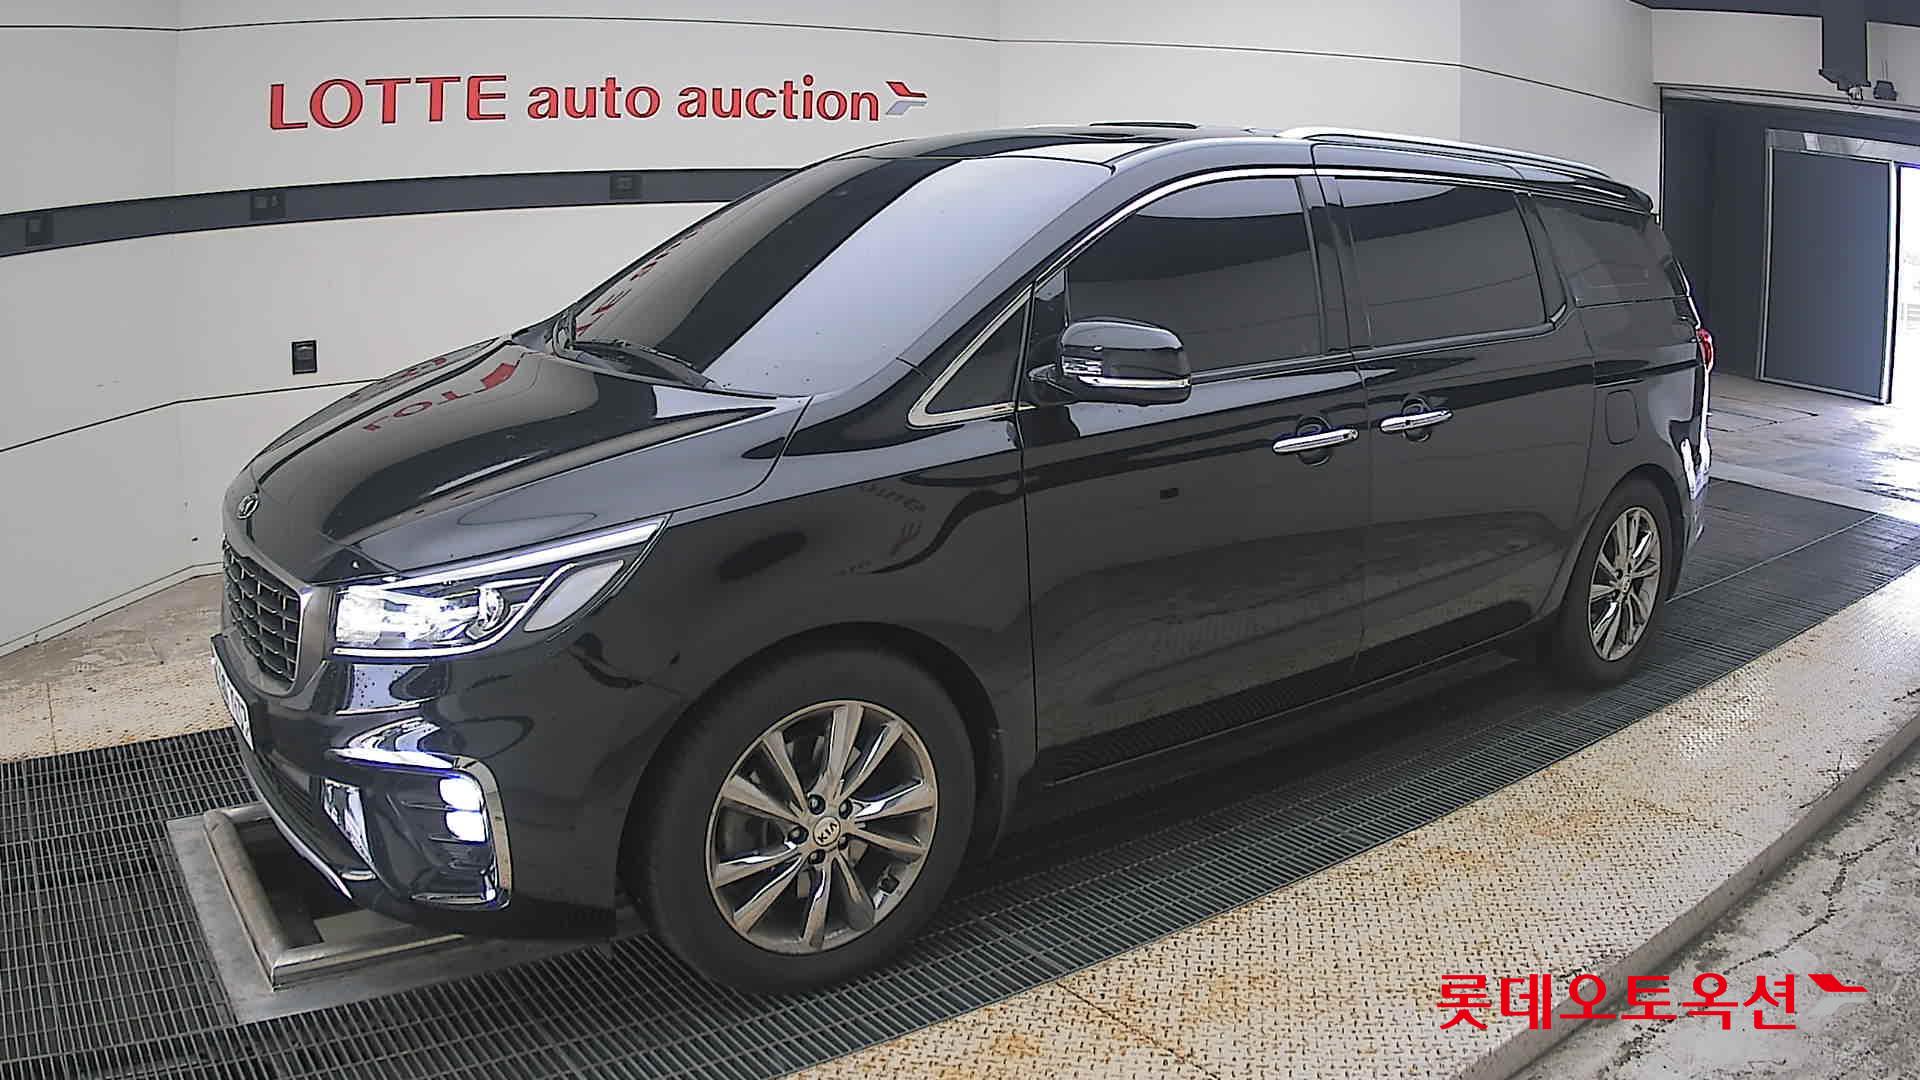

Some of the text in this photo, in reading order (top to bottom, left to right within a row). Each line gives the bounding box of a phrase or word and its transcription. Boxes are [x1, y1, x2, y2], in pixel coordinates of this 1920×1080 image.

[270, 75, 881, 130] LOTTE auto auction
[817, 822, 838, 843] KIA
